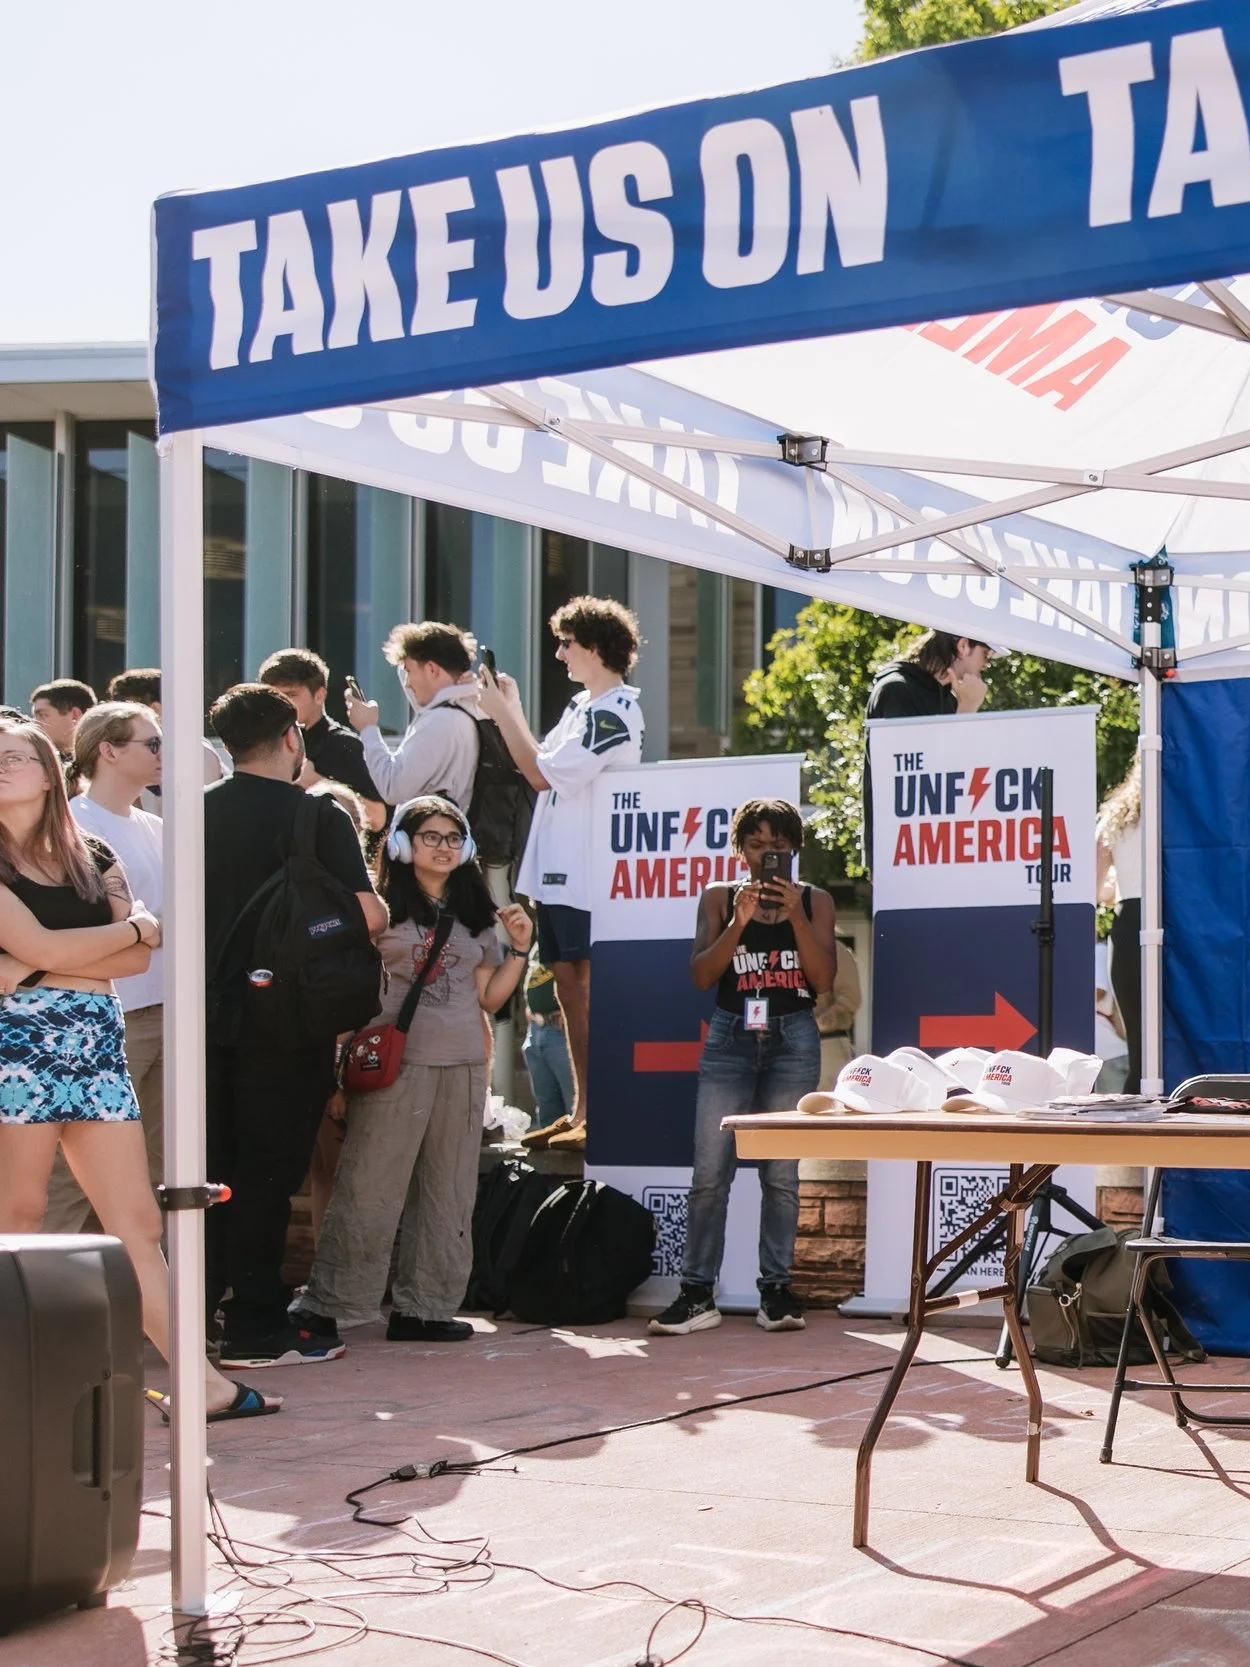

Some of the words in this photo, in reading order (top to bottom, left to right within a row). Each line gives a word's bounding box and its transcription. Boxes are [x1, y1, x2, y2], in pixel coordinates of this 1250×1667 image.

[192, 176, 478, 369] TAKE
[495, 140, 674, 319] US
[700, 95, 888, 289] ON
[893, 752, 924, 772] THE
[612, 792, 641, 810] THE
[610, 806, 737, 853] UNFC
[893, 816, 1071, 867] AMERICA
[609, 856, 749, 900] AMERIC
[734, 944, 747, 955] HE
[737, 969, 807, 991] AMERIC
[949, 1267, 978, 1276] SAN
[980, 1267, 1004, 1277] HERE
